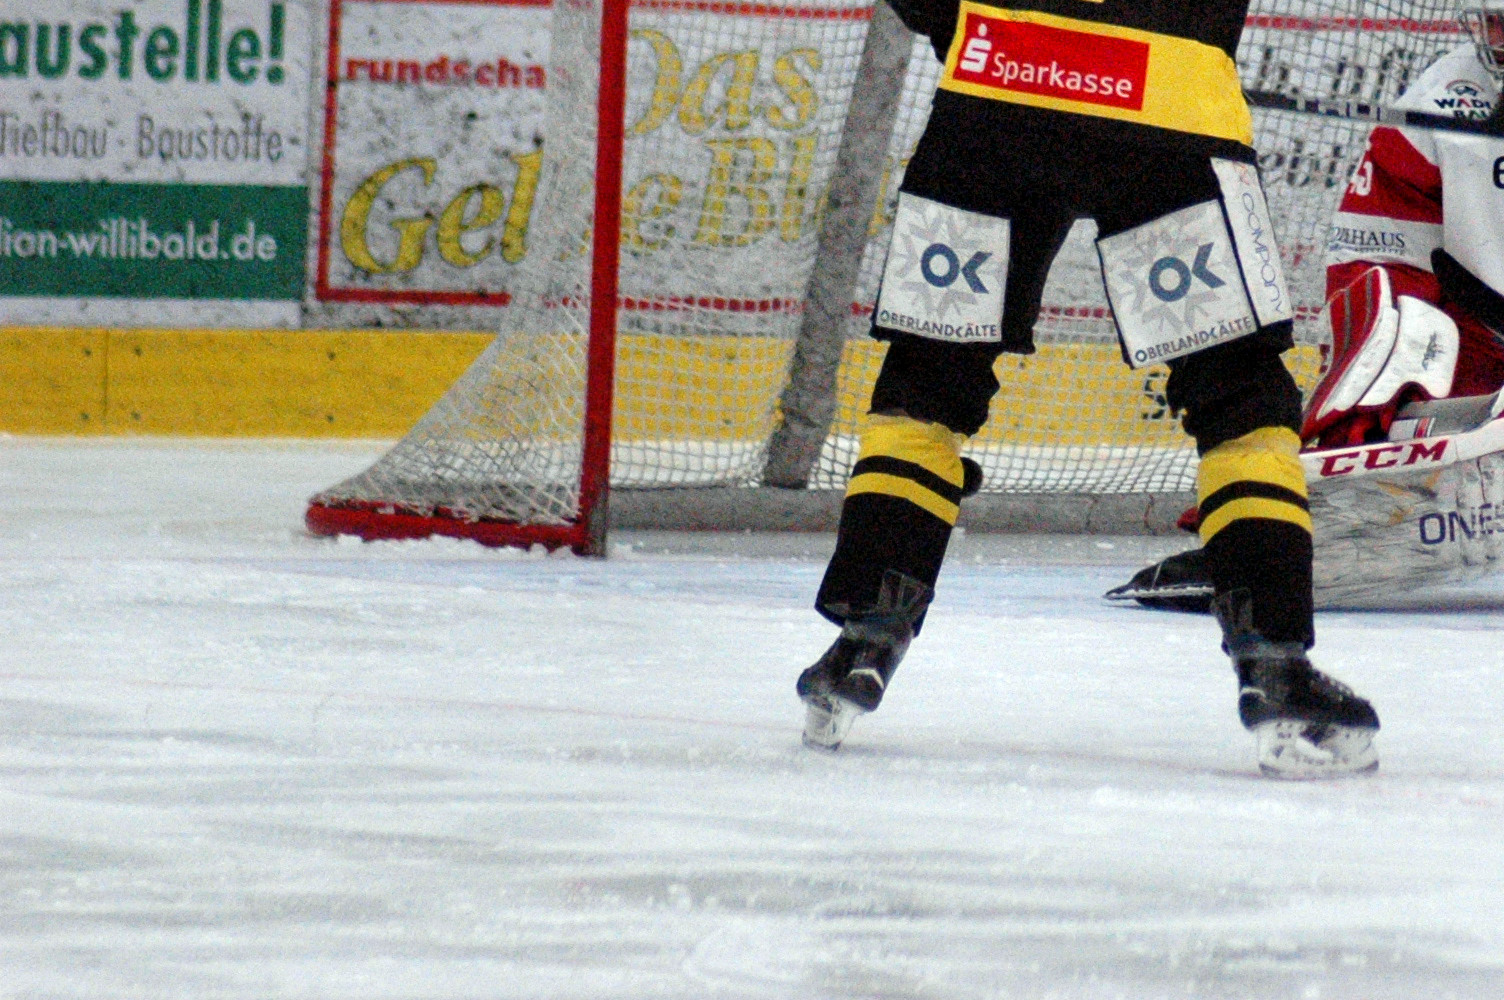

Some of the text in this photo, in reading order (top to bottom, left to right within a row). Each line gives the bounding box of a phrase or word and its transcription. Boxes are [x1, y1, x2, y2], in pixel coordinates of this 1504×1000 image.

[346, 55, 556, 90] rundscha
[991, 51, 1133, 100] Sparkasse
[919, 241, 995, 296] OK
[1148, 240, 1228, 303] OK
[1320, 439, 1450, 477] CCM
